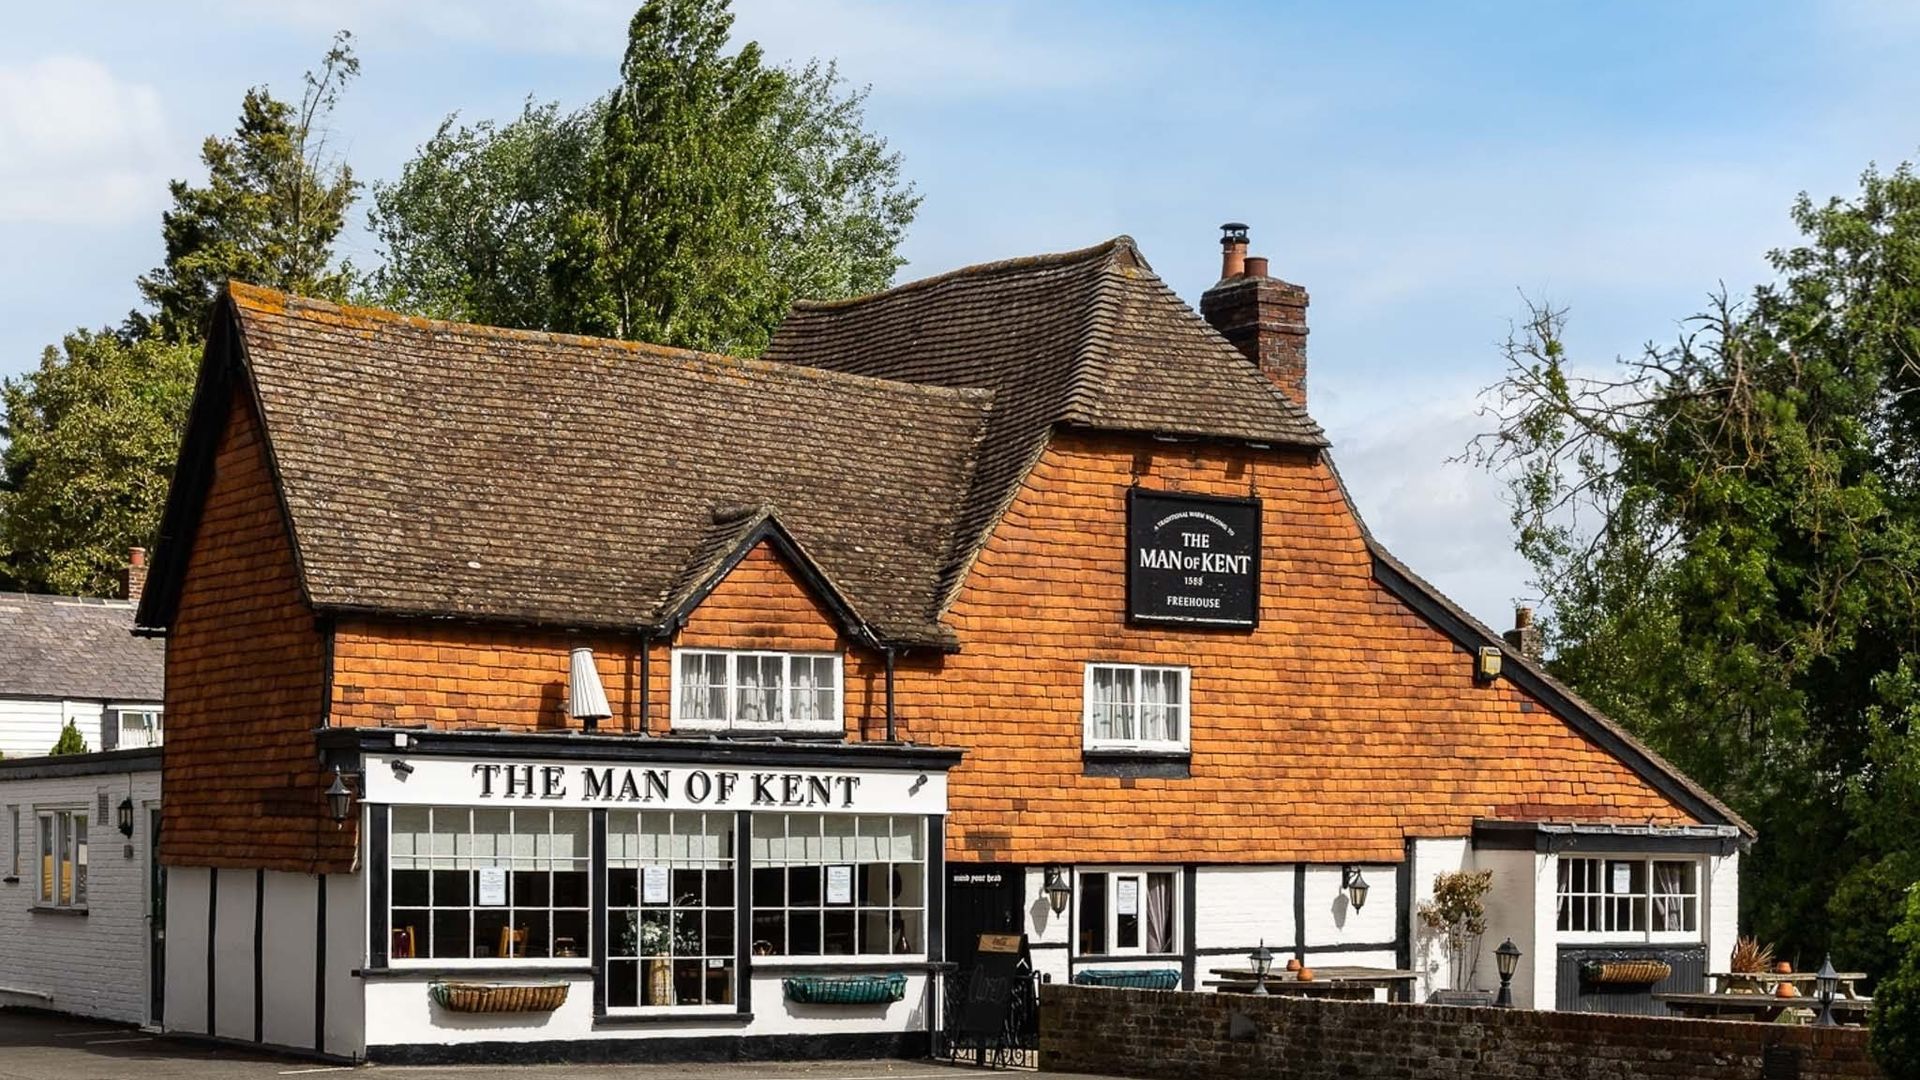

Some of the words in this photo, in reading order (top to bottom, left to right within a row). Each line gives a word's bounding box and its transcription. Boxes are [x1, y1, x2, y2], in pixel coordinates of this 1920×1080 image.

[1181, 532, 1210, 548] THE
[1140, 548, 1182, 570] MAN
[1184, 557, 1200, 570] OF
[1201, 552, 1251, 574] KENT
[1167, 595, 1221, 608] FREEHOUSE
[472, 763, 567, 800] THE
[581, 766, 671, 803] MAN
[685, 770, 739, 805] OF
[750, 772, 861, 809] KENT
[987, 874, 1002, 882] head
